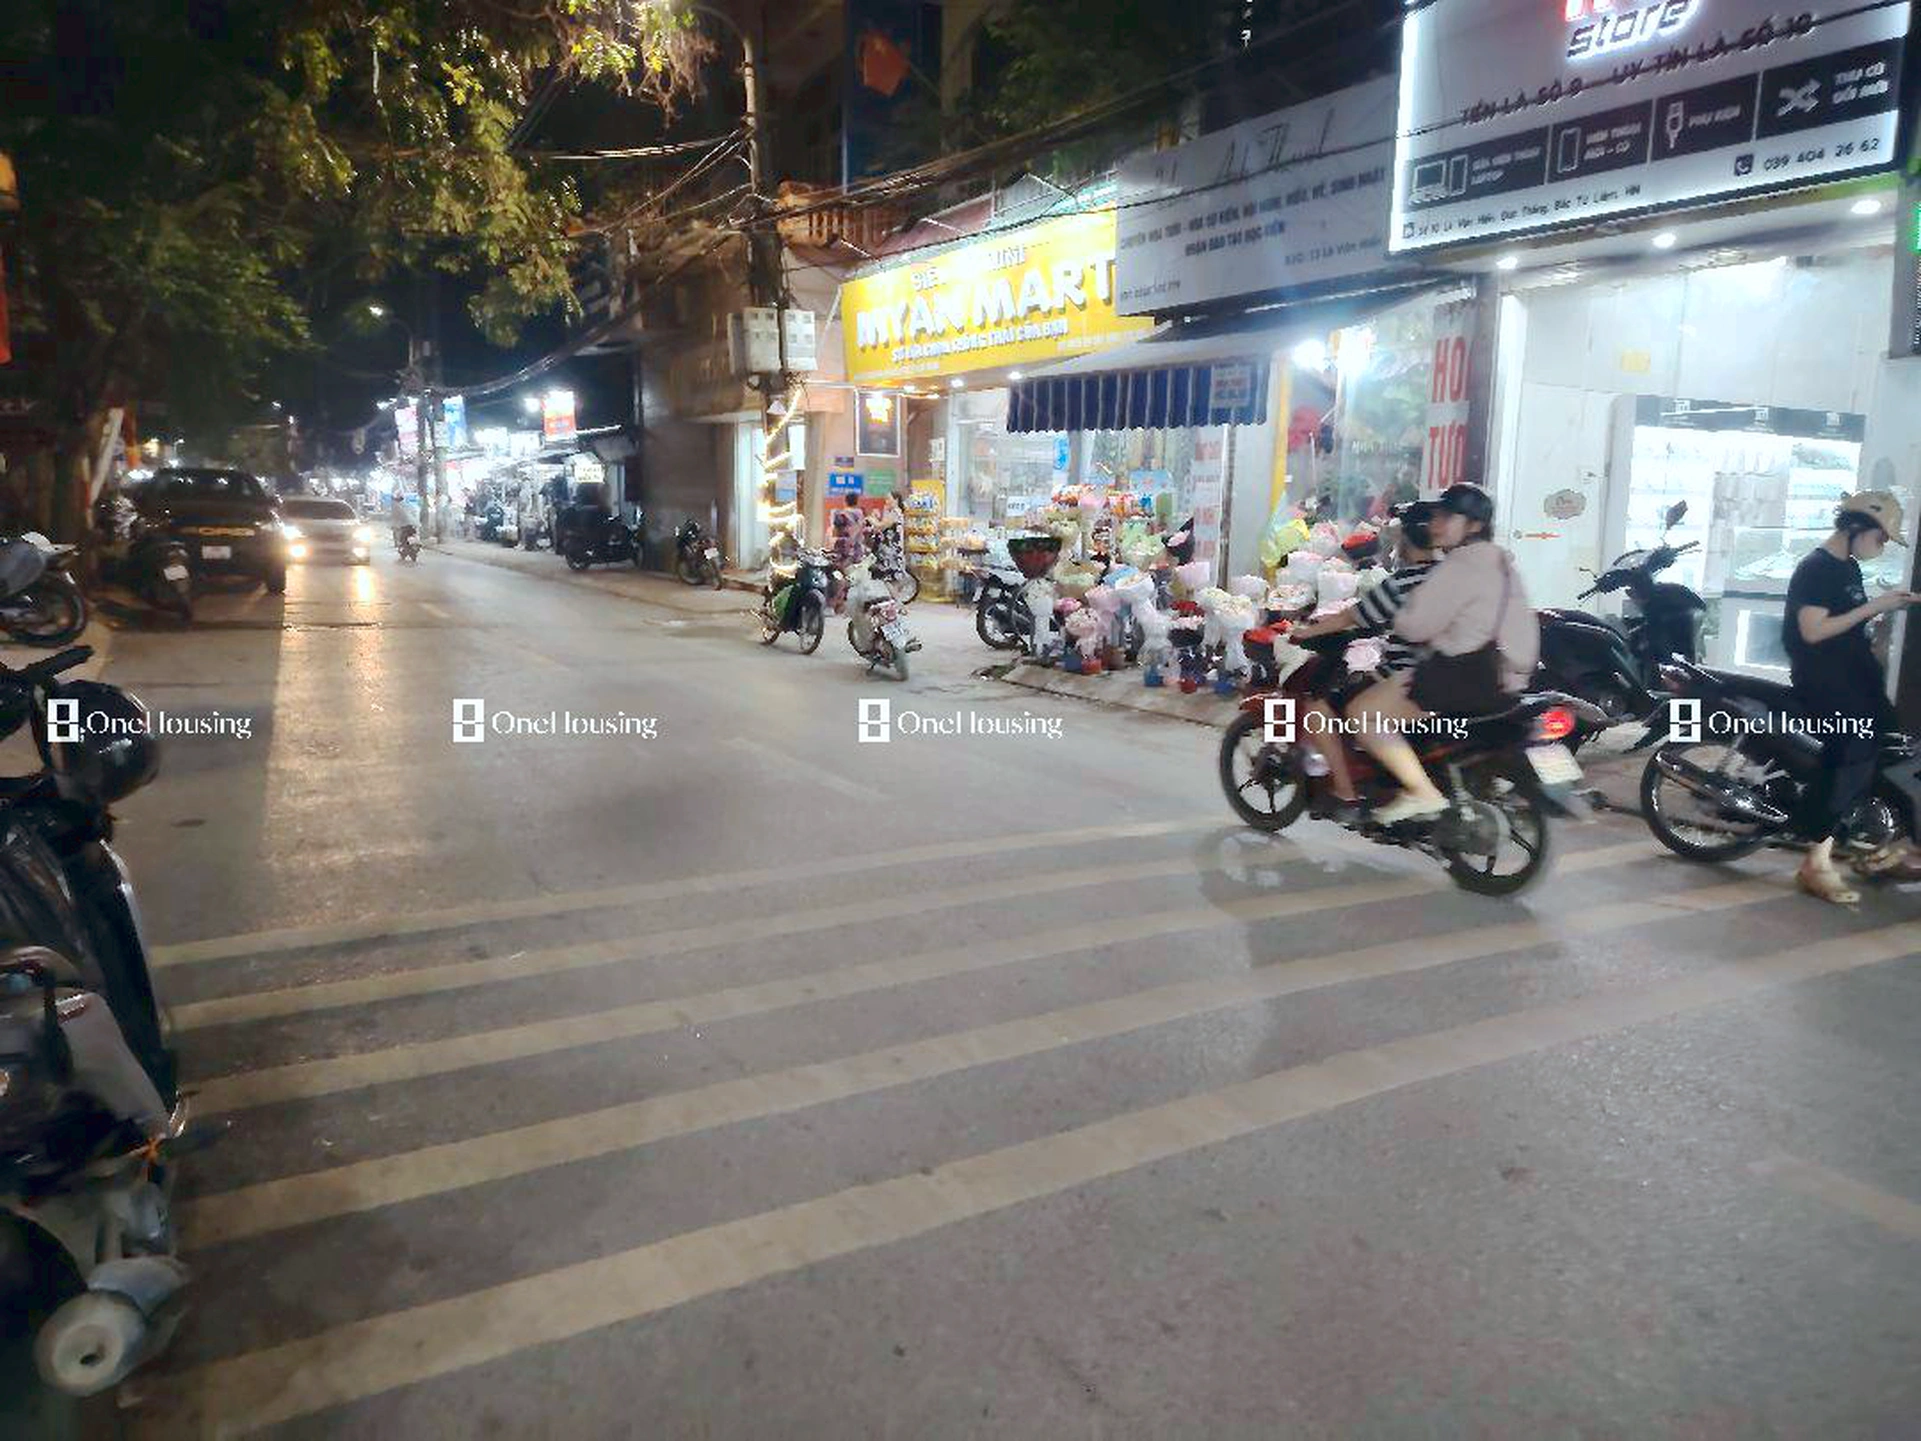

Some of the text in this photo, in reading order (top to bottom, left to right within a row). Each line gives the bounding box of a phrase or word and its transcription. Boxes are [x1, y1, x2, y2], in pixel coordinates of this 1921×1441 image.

[1566, 0, 1695, 58] store
[1763, 154, 1790, 172] 039
[968, 252, 1117, 327] MART
